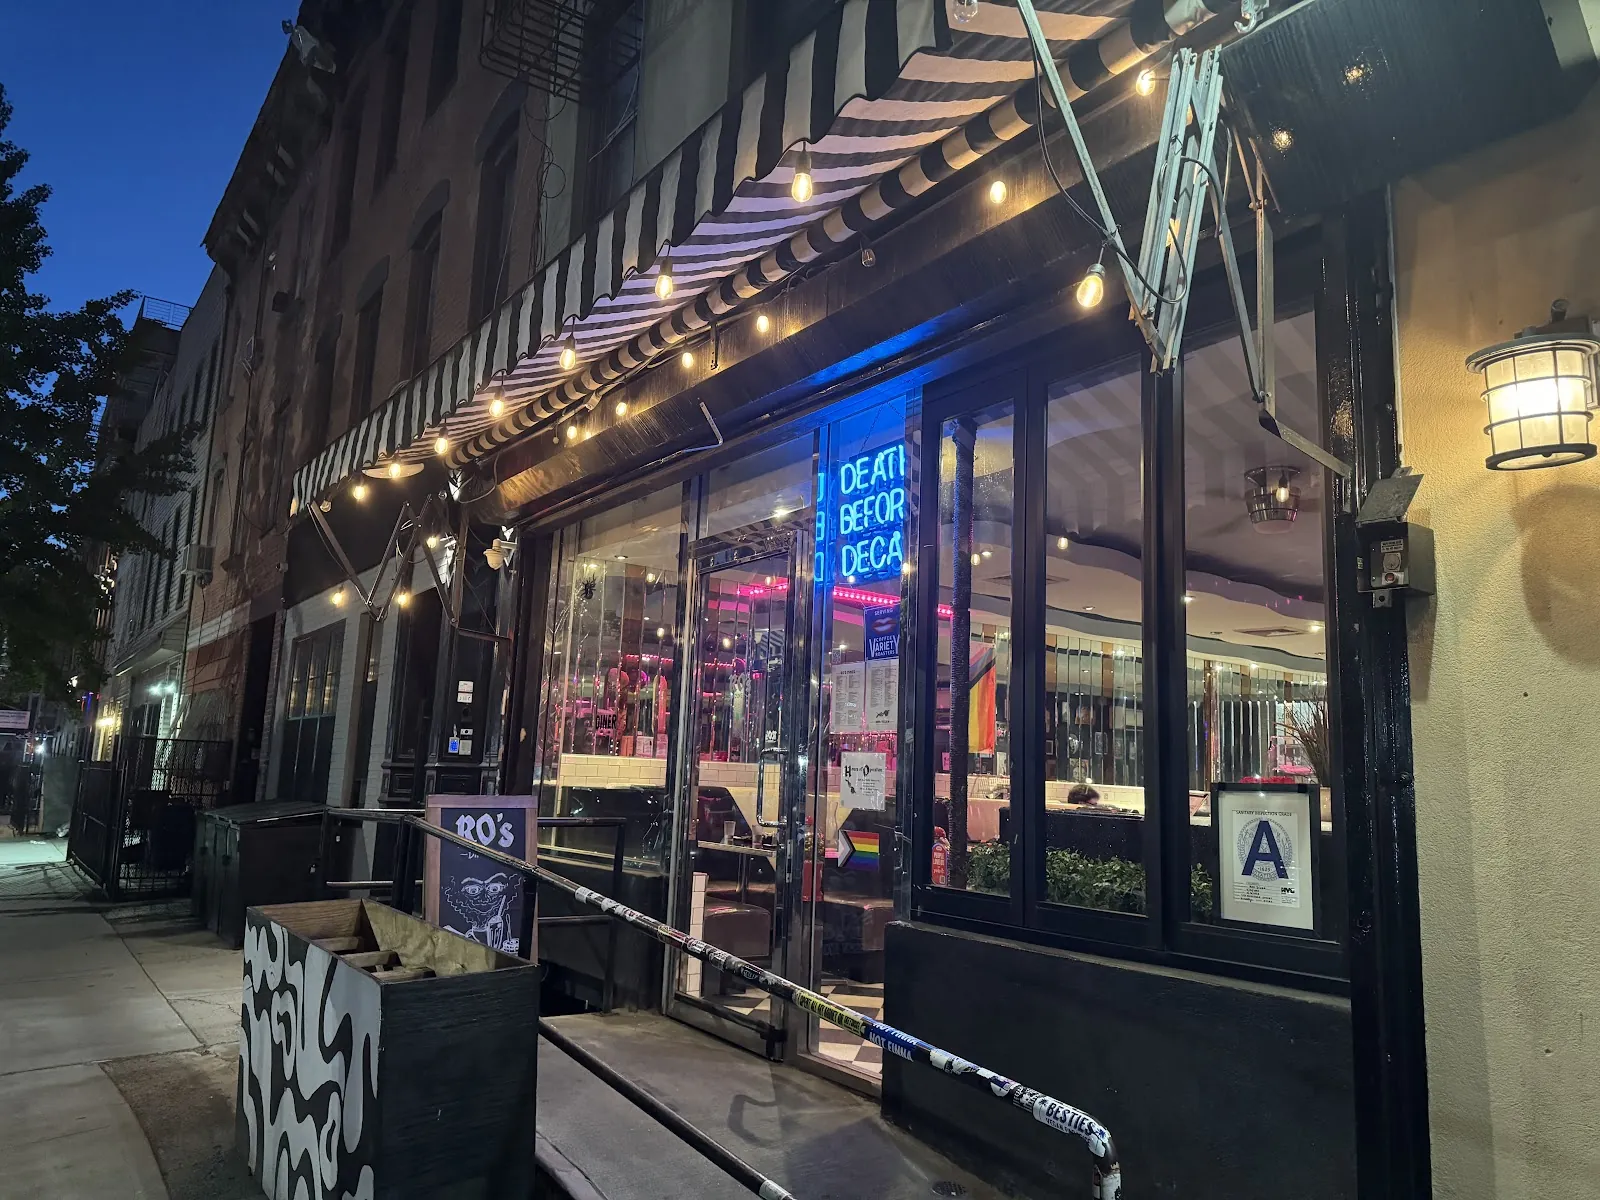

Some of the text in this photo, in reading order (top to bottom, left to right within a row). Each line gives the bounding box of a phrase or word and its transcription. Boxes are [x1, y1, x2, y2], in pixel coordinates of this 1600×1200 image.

[839, 488, 905, 535] BEFOR
[840, 530, 903, 577] DECA
[874, 608, 894, 616] SERVING
[869, 634, 900, 658] VARIETY
[596, 714, 617, 730] DINER
[1241, 820, 1289, 880] A
[1046, 1102, 1094, 1136] BESTIES
